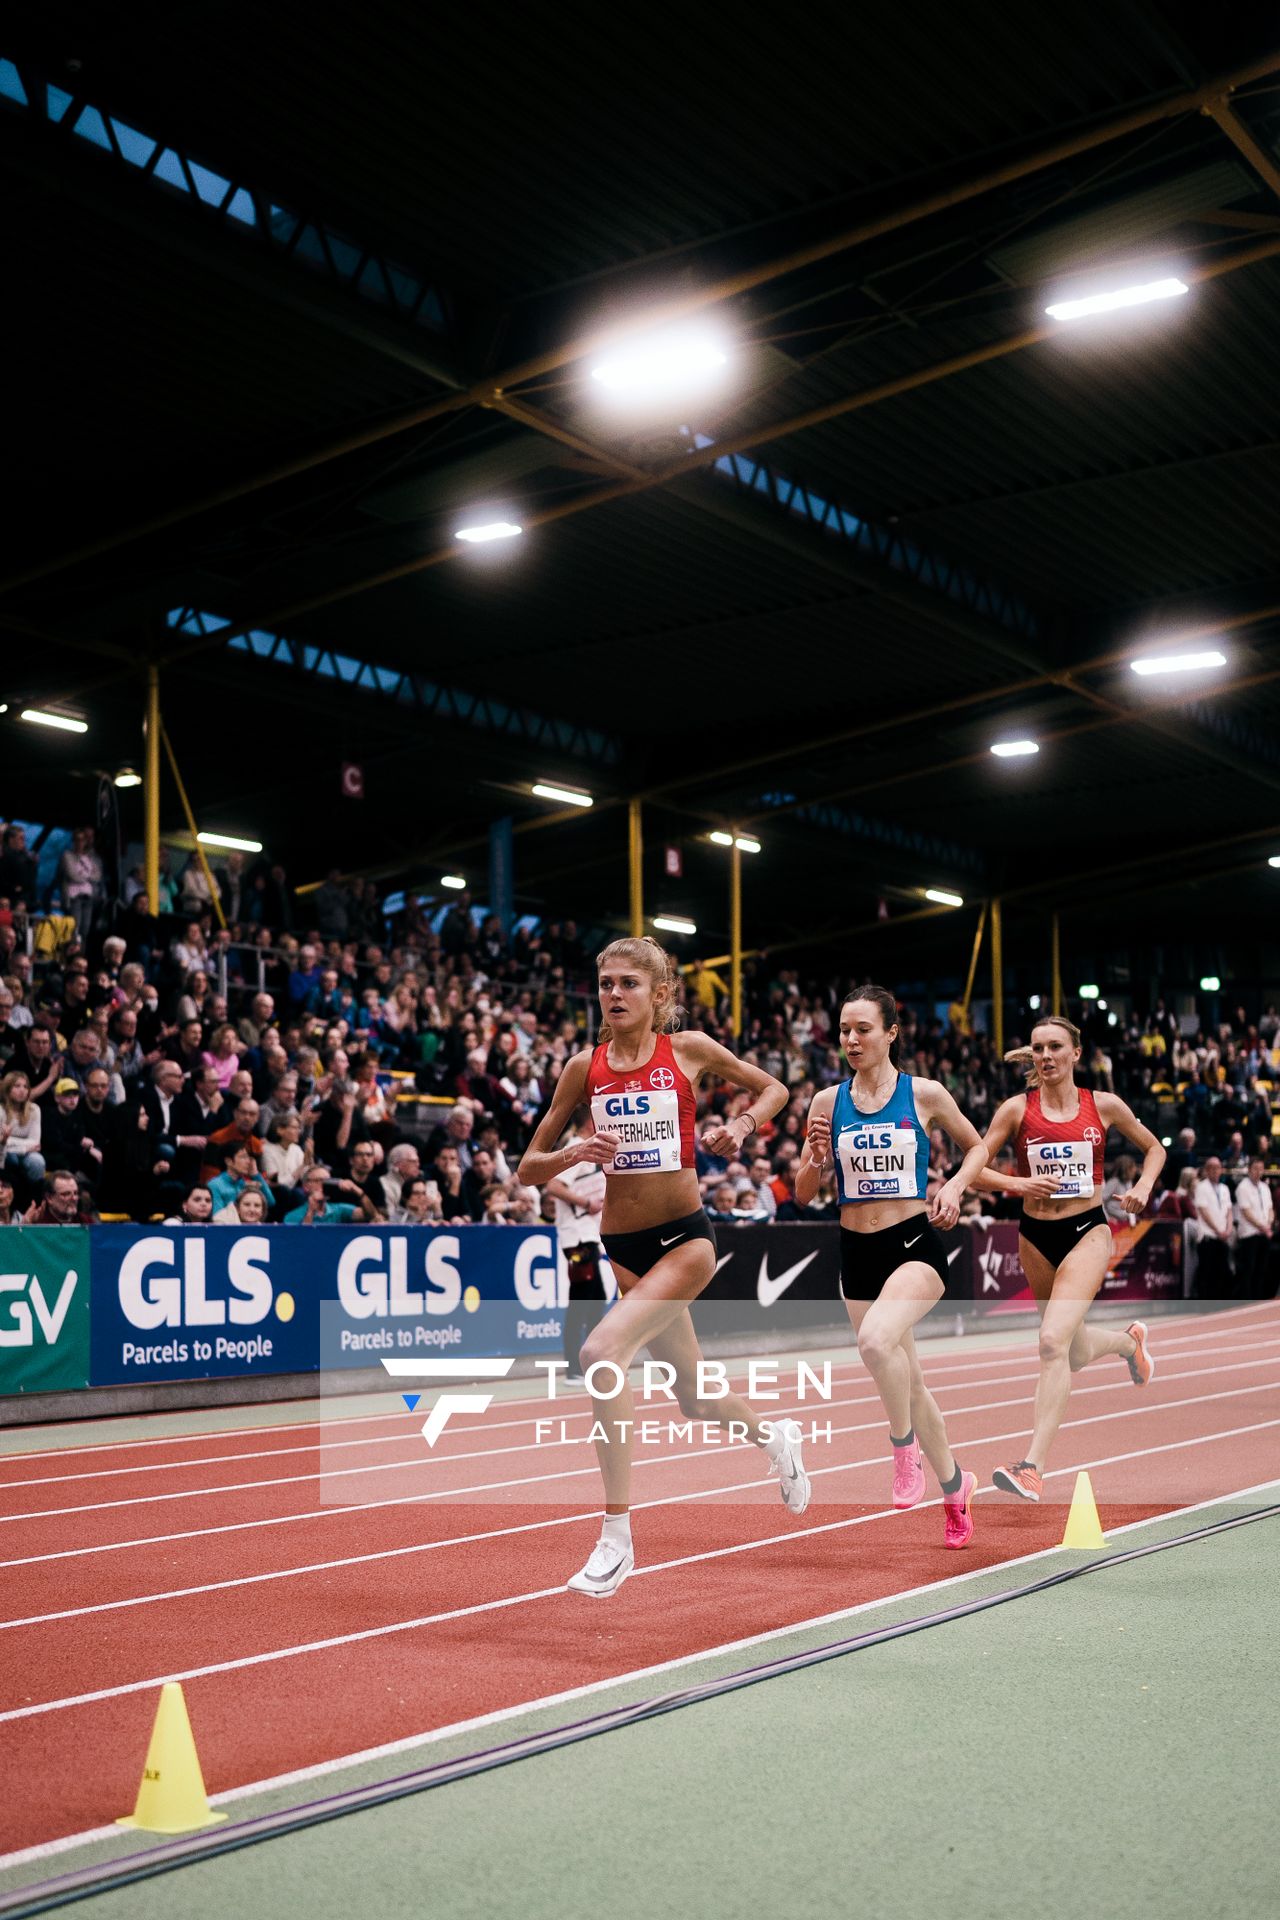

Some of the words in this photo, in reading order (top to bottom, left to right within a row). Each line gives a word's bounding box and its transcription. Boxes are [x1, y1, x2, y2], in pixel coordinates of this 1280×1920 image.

[344, 767, 361, 793] C
[631, 1153, 659, 1163] PLAN
[850, 1155, 905, 1173] KLEIN
[1036, 1163, 1087, 1177] MEYER
[874, 1181, 898, 1190] PLAN
[341, 1328, 394, 1351] Parcels
[398, 1329, 413, 1347] to
[415, 1324, 462, 1348] People
[516, 1319, 562, 1339] Parcels
[122, 1339, 188, 1365] Parcels
[193, 1341, 212, 1360] to
[216, 1334, 273, 1362] People
